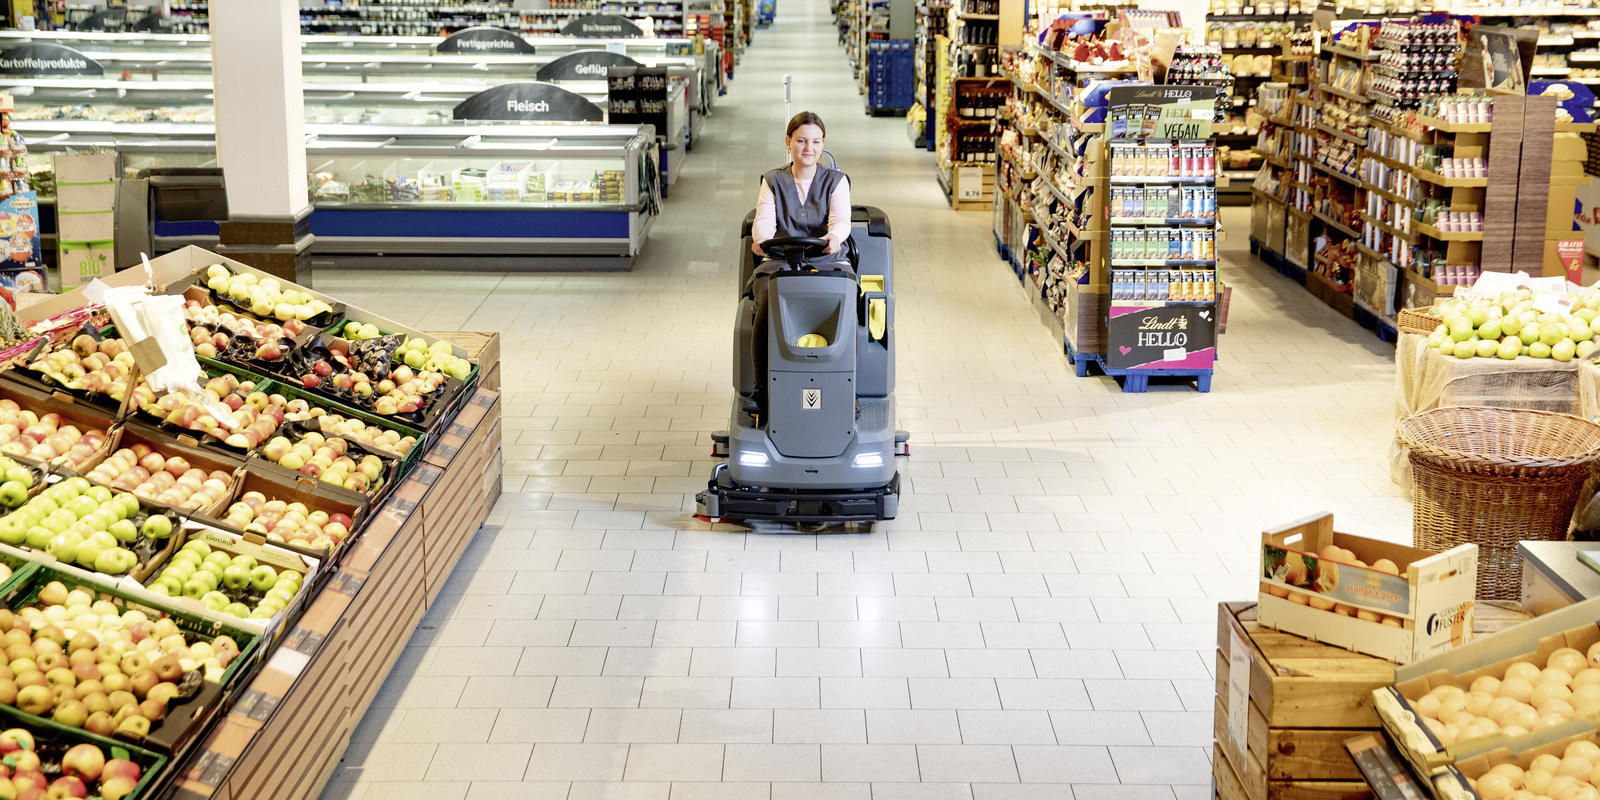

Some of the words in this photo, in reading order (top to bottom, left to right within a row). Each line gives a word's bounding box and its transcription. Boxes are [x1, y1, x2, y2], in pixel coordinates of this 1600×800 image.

[582, 23, 622, 33] Backwaren
[457, 38, 515, 50] Fertiggerichte
[575, 64, 609, 77] Geflüg
[1133, 89, 1157, 98] Lindt
[1163, 89, 1193, 98] HELLO
[506, 99, 550, 113] Fleisch
[1165, 108, 1193, 118] HELL
[1164, 123, 1200, 139] VEGAN
[80, 260, 101, 276] BIO
[1137, 316, 1179, 330] Lindt
[1137, 331, 1188, 347] HELLO
[1440, 603, 1466, 618] GERMANS
[1439, 610, 1466, 631] FUSTER
